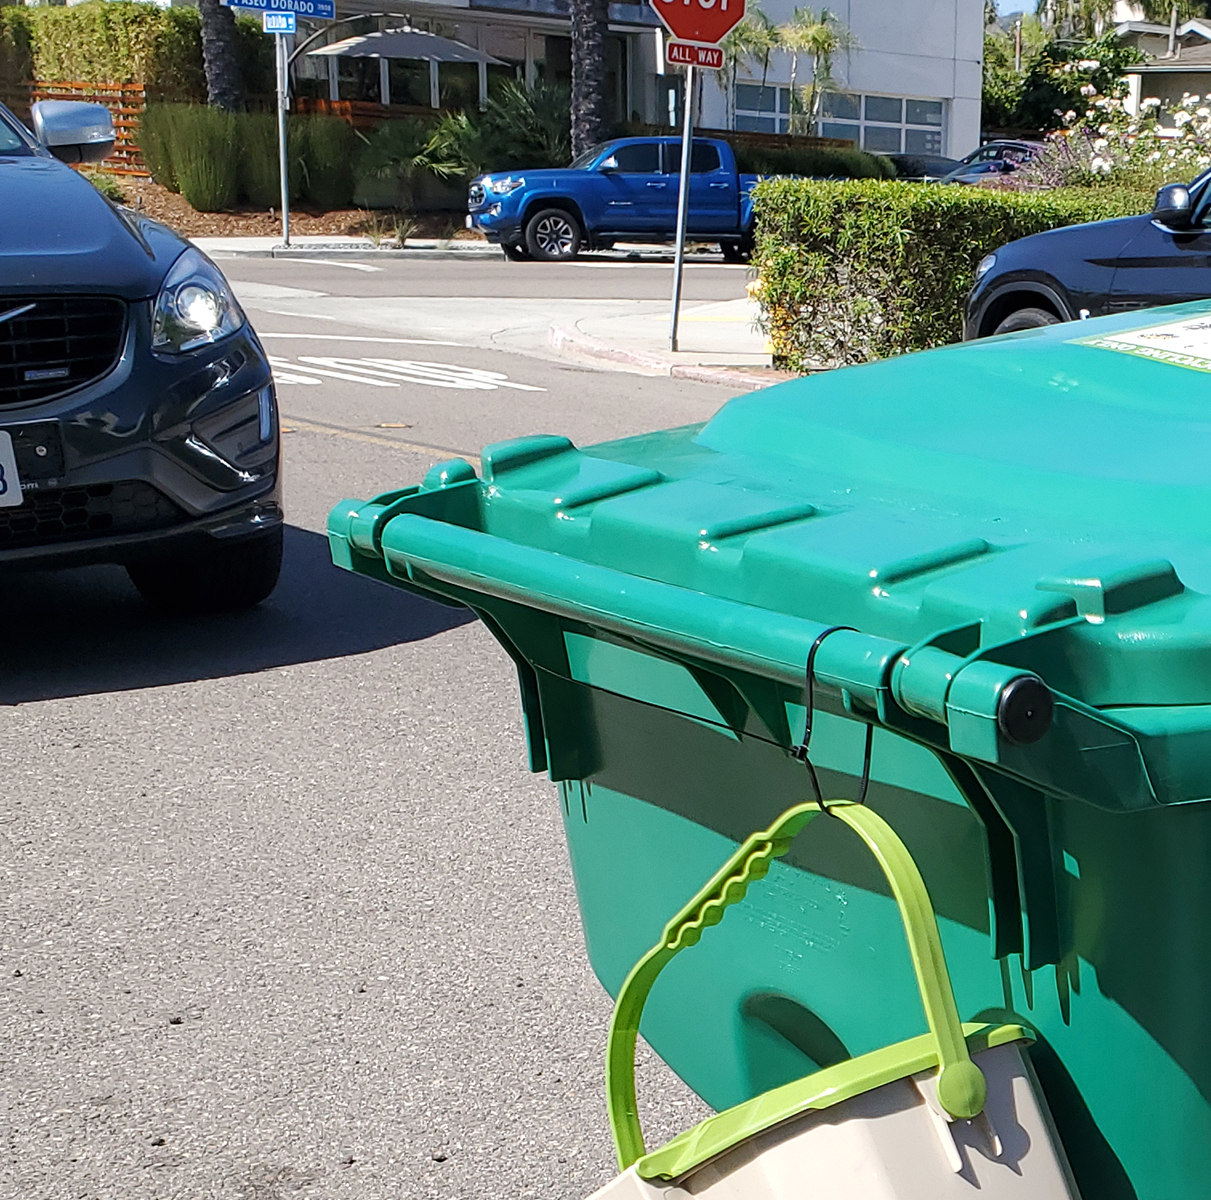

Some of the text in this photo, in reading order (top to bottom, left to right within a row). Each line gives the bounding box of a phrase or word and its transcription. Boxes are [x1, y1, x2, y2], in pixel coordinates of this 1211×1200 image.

[271, 0, 314, 13] DORADO
[671, 47, 719, 64] ALL WAY
